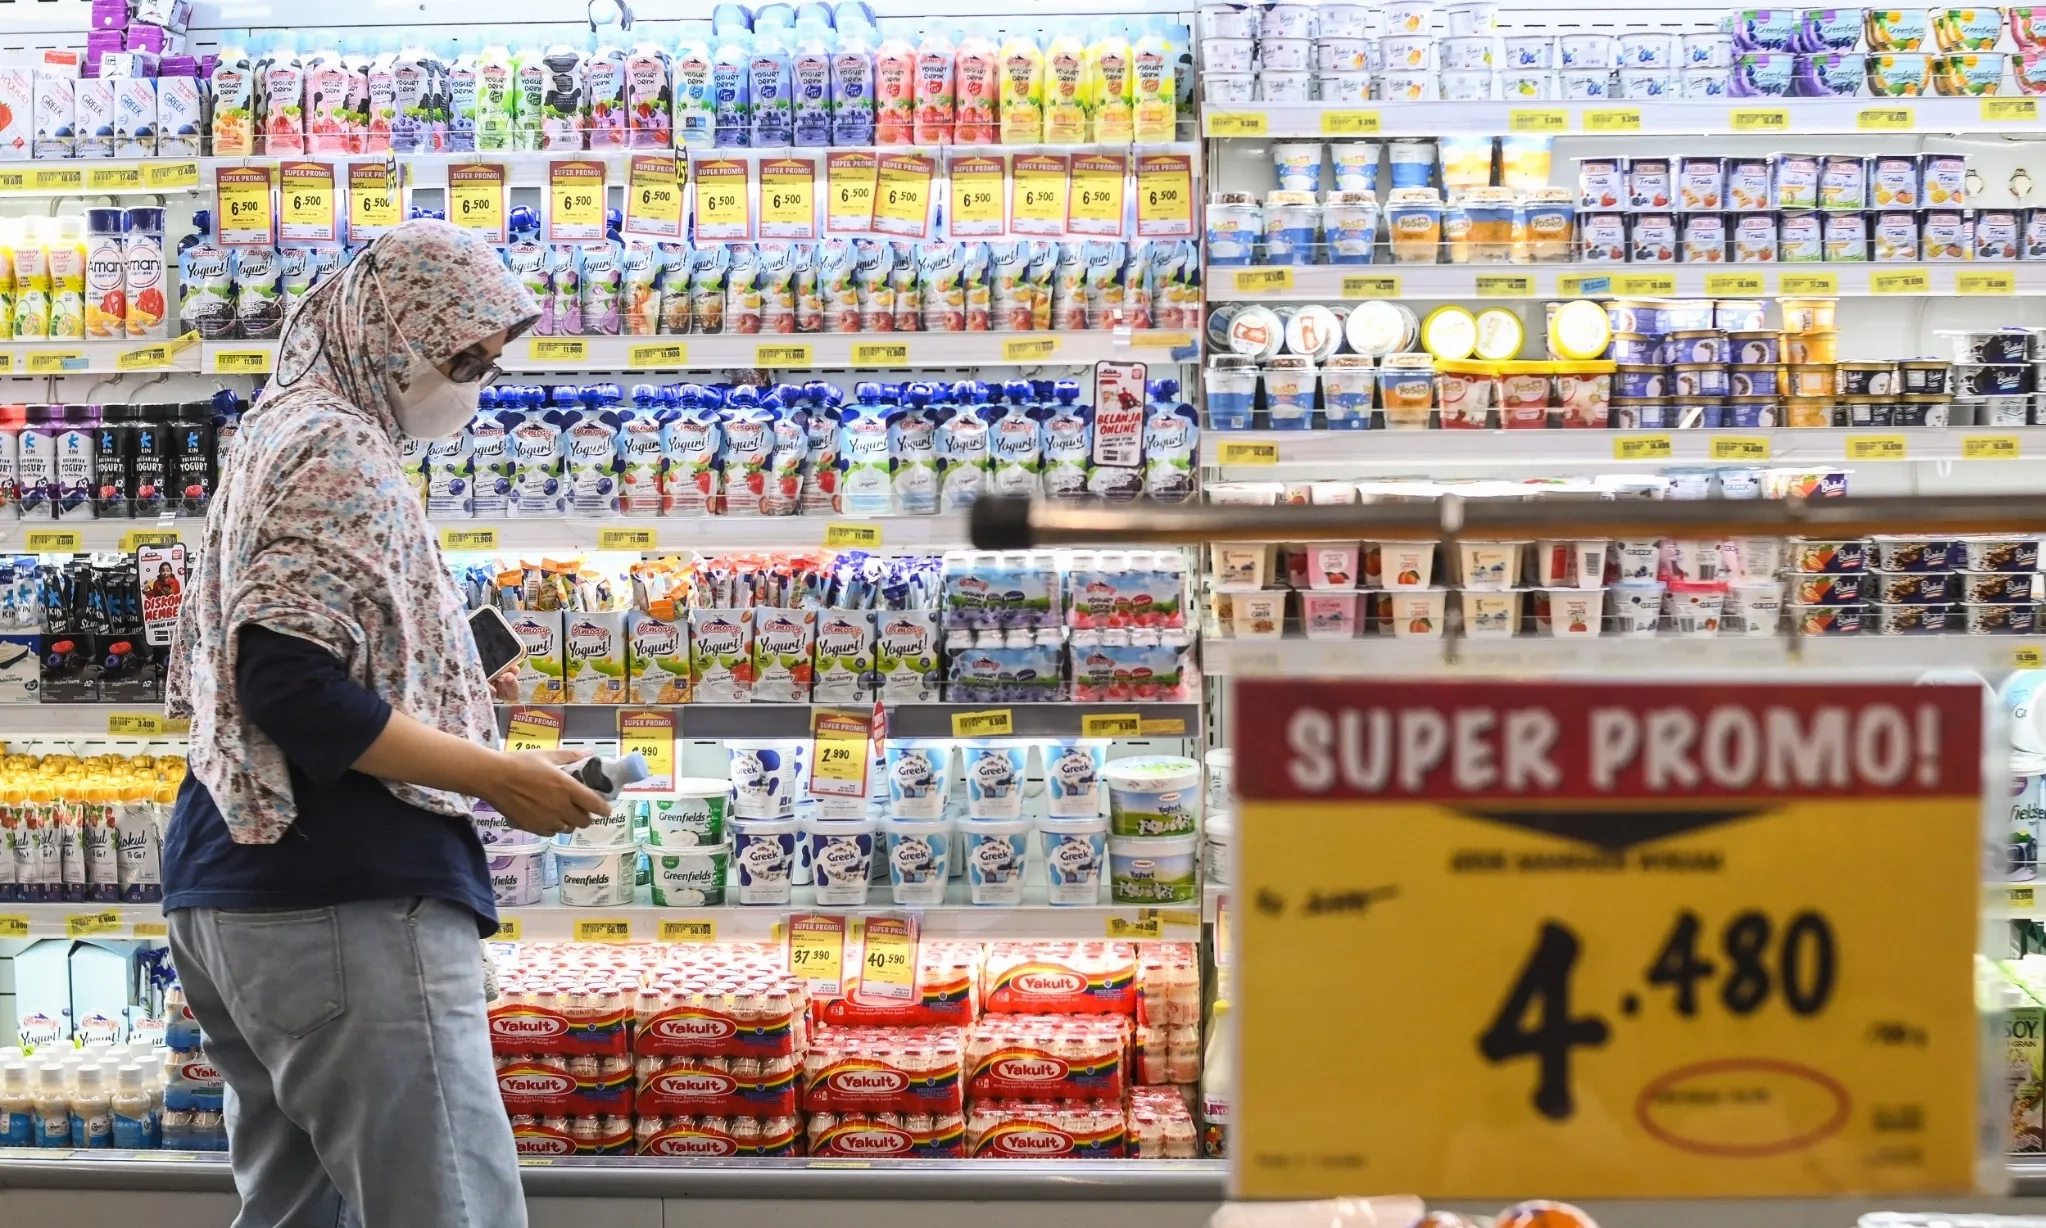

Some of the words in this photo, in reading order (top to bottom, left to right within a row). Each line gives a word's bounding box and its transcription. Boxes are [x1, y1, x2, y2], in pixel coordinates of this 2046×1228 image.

[42, 94, 64, 117] GREEK
[82, 94, 104, 117] GREEK
[121, 93, 144, 117] GREEK
[164, 92, 185, 116] GREEK
[635, 163, 655, 172] SUPER
[656, 164, 675, 174] PROM
[764, 166, 783, 174] SUPER
[784, 166, 811, 174] PROMO!
[831, 160, 851, 168] SUPER
[853, 160, 876, 168] PROMO
[882, 161, 902, 170] SUPER
[903, 163, 930, 172] PROMO!
[953, 165, 973, 173] SUPER
[1038, 163, 1064, 171] PROMO!
[1096, 162, 1122, 171] PROMO!
[1139, 163, 1160, 171] SUPER
[1161, 163, 1187, 171] PROMO!
[284, 169, 305, 177] SUPER
[306, 170, 331, 178] PROMO!
[474, 172, 500, 180] PROMO!
[575, 169, 600, 177] PROMO!
[699, 167, 718, 175] SUPER
[719, 167, 744, 175] PROMO!
[642, 190, 670, 204] 6.500
[773, 194, 801, 208] 6.500
[841, 188, 869, 202] 6.500
[889, 190, 917, 204] 6.500
[963, 193, 991, 207] 6.500
[1026, 191, 1054, 205] 6.500
[1083, 191, 1111, 205] 6.500
[1150, 190, 1177, 205] 6.500
[231, 201, 258, 215] 6.500
[293, 195, 321, 210] 6.500
[462, 199, 489, 214] 6.500
[564, 196, 592, 210] 6.500
[708, 195, 735, 210] 6.500
[187, 256, 229, 278] Yogurt!
[563, 346, 583, 354] 11.900
[661, 350, 680, 358] 11.900
[1097, 413, 1142, 425] BELANJA
[516, 427, 554, 438] Cimory
[573, 427, 609, 437] Cimory
[1100, 424, 1136, 435] ONLINE
[514, 437, 557, 459] Yogurt!
[570, 437, 611, 459] Yogurt!
[668, 432, 710, 454] Yogurt!
[897, 434, 936, 452] Yogurt!
[996, 436, 1037, 454] Yogurt!
[61, 465, 88, 473] YOGURT
[136, 463, 163, 472] YOGURT
[180, 463, 208, 472] YOGURT
[473, 535, 493, 543] 11.900
[629, 535, 649, 543] 11.900
[144, 594, 182, 610] DISKON
[145, 606, 178, 621] MEMBE
[571, 623, 609, 638] Cimory
[637, 623, 677, 636] Cimory
[701, 622, 742, 636] Cimory
[764, 621, 804, 636] Cimory
[822, 623, 863, 637] Cimory
[885, 623, 926, 637] Cimory
[569, 637, 611, 659] Yogurt!
[634, 632, 679, 658] Yogurt!
[698, 632, 744, 657] Yogurt!
[760, 632, 805, 657] Yogurt!
[819, 633, 864, 658] Yogurt!
[882, 633, 927, 658] Yogurt!
[706, 674, 736, 683] Strawberry
[764, 674, 793, 683] Strawberry
[824, 674, 853, 683] Blueberry
[890, 674, 918, 683] Blueberry
[137, 719, 155, 728] 3.490
[513, 713, 533, 723] SUPER
[534, 716, 559, 728] PROMO!
[645, 719, 671, 727] PROMO!
[820, 721, 840, 730] SUPER
[841, 722, 867, 732] PROMO!
[1287, 707, 1561, 790] SUPER
[1590, 704, 1943, 788] PROMO!
[821, 748, 850, 763] 2.990
[735, 765, 758, 775] Greek
[899, 765, 927, 777] Greek
[978, 764, 1007, 776] Greek
[1061, 763, 1090, 774] Greek
[590, 813, 626, 826] eenfields
[658, 811, 706, 824] Greenfields
[114, 828, 147, 849] Biokul
[749, 850, 779, 862] Greek
[827, 851, 856, 863] Greek
[899, 850, 927, 861] Greek
[979, 850, 1009, 861] Greek
[1060, 849, 1089, 861] Greek
[564, 874, 609, 886] Greenfields
[663, 870, 712, 881] Greenfields
[1130, 870, 1155, 880] Yoghurt
[606, 927, 628, 935] 50.190
[690, 927, 711, 935] 50.190
[794, 922, 813, 930] SUPER
[814, 923, 842, 932] PROMO!
[869, 925, 890, 933] SUPER
[891, 926, 908, 935] PROM
[793, 950, 830, 965] 37.390
[867, 953, 905, 968] 40.590
[1024, 977, 1074, 990] Yakult
[1477, 910, 1838, 1121] 4.480
[500, 1020, 553, 1034] Yakult
[667, 1021, 720, 1035] Yakult
[195, 1067, 220, 1078] Yak
[1000, 1063, 1053, 1076] Yakult
[507, 1079, 561, 1092] Yakult
[667, 1079, 720, 1091] Yakult
[842, 1075, 895, 1088] Yakult
[667, 1141, 720, 1154] Yakult
[845, 1135, 900, 1149] Yakult
[1007, 1135, 1060, 1149] Yakult
